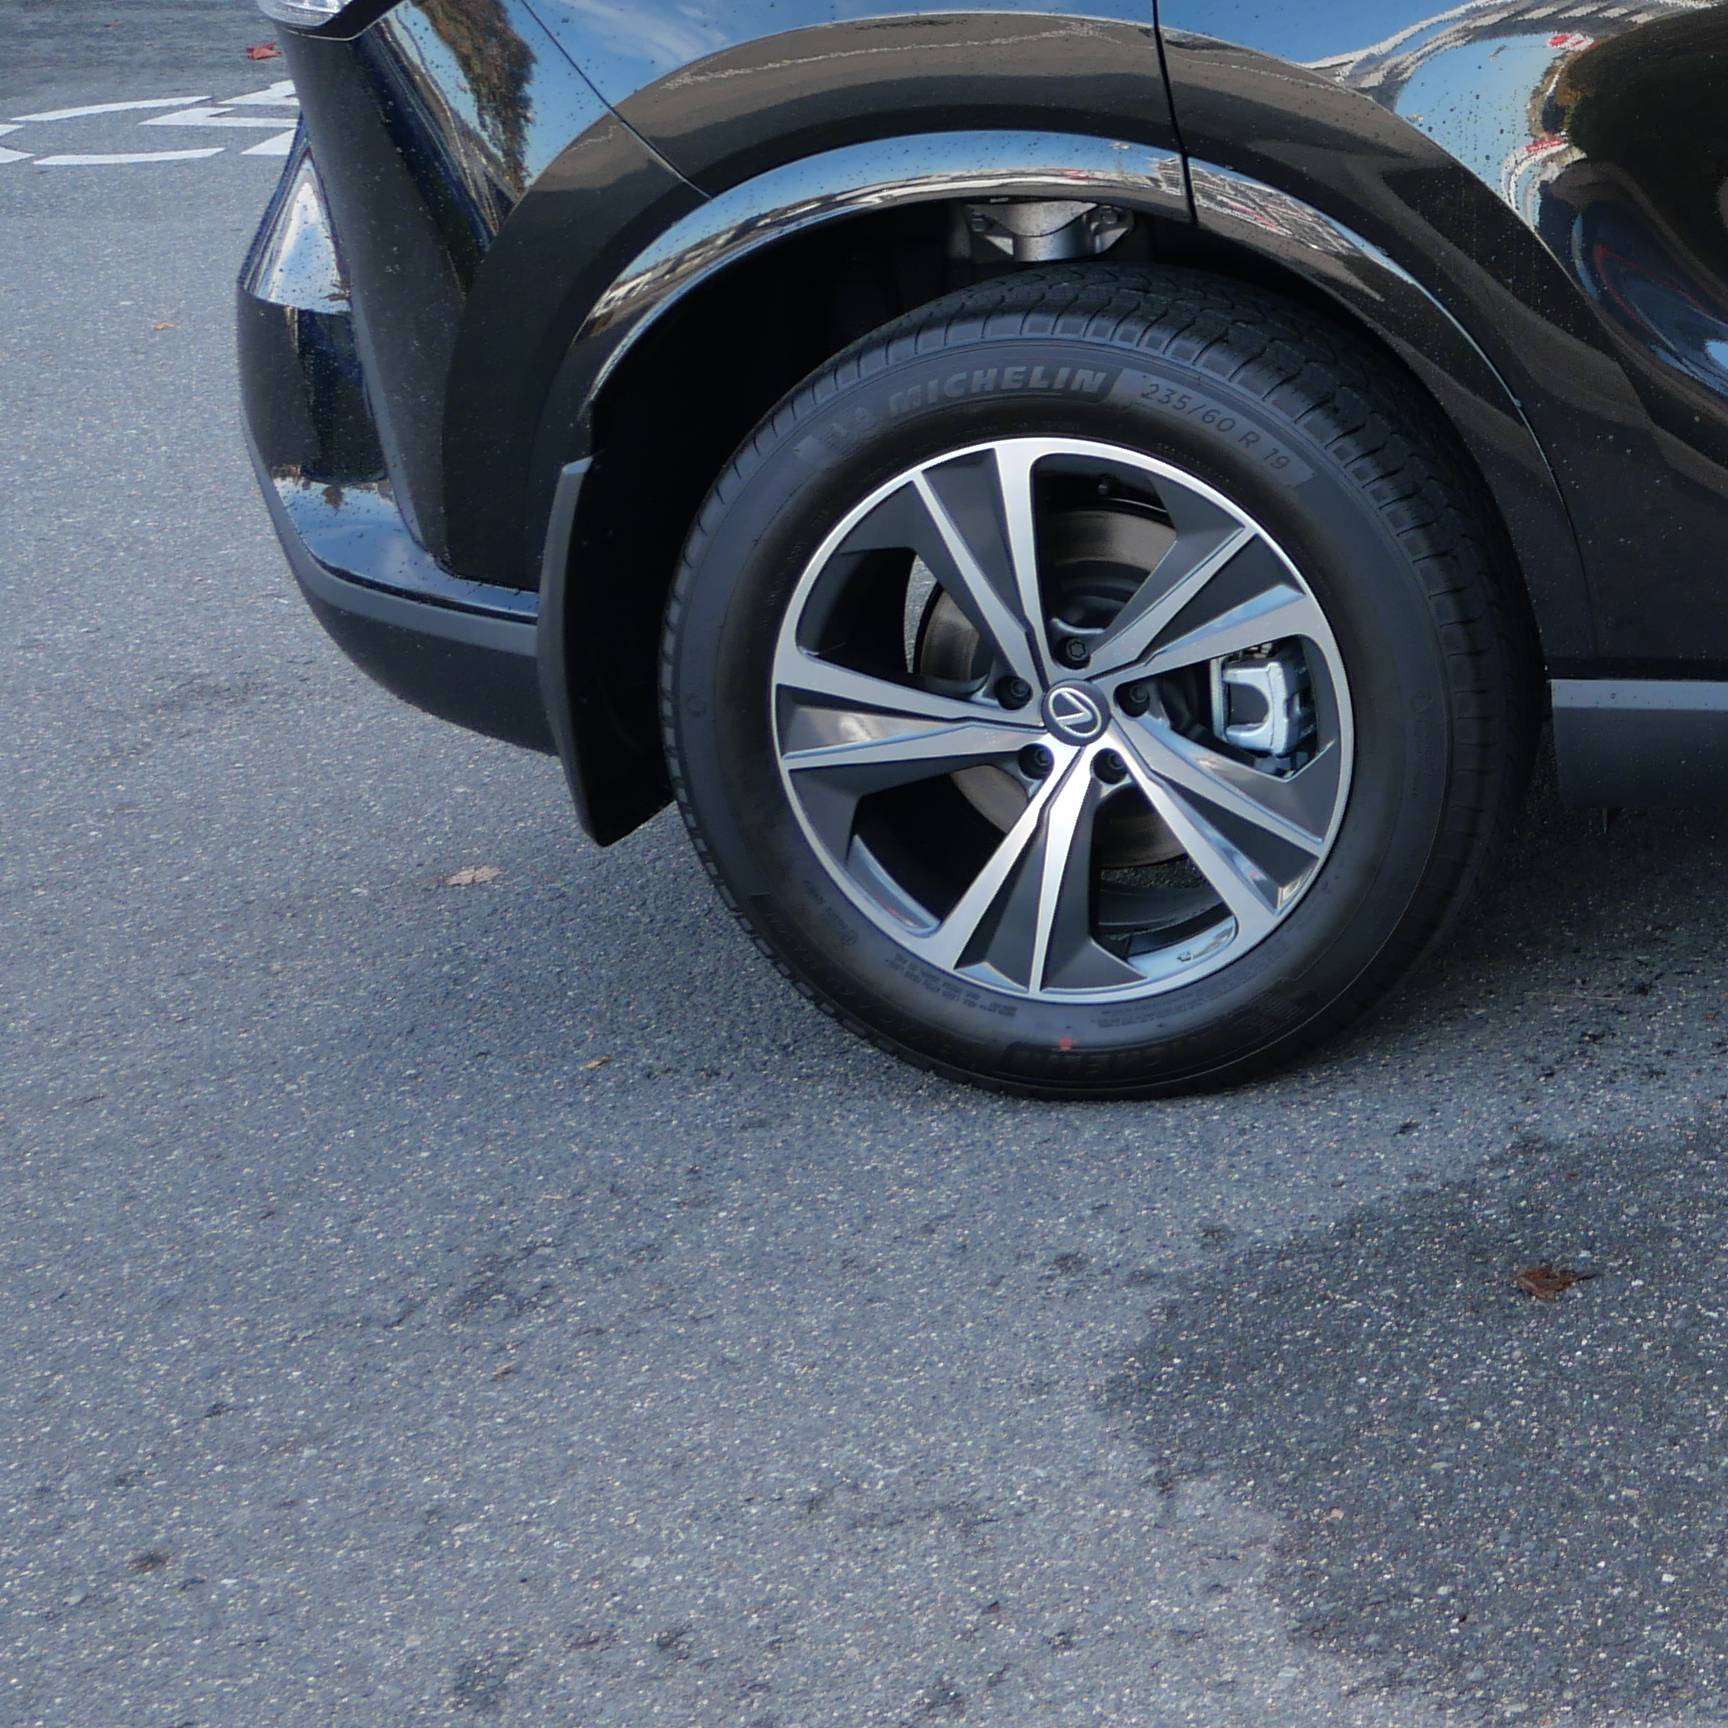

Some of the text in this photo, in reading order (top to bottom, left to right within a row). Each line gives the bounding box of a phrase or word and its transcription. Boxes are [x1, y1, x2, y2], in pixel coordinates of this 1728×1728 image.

[888, 363, 1108, 415] MICHELIN
[1140, 382, 1292, 473] 235/60 R 19
